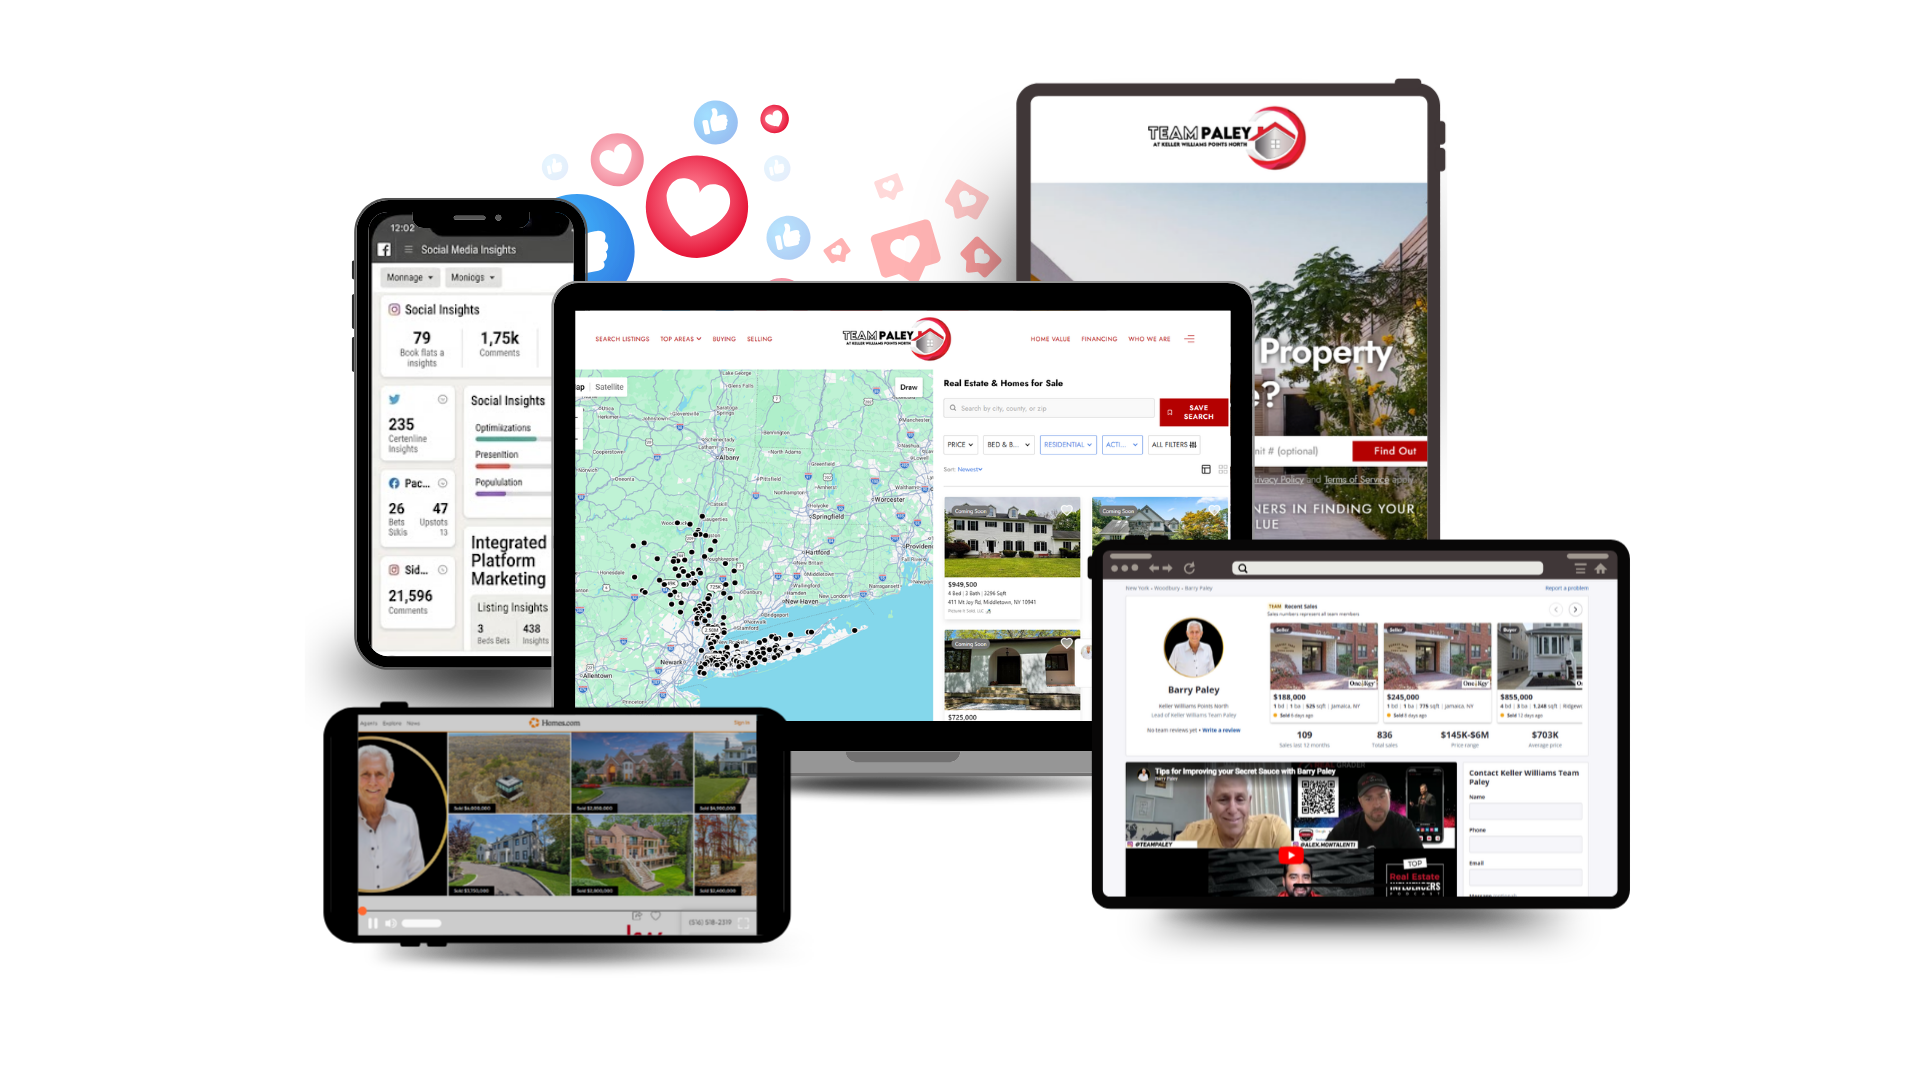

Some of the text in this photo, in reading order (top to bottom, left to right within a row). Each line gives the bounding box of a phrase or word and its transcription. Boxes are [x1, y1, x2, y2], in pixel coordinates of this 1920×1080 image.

[1148, 126, 1252, 140] TEAM PALEY
[391, 223, 416, 232] 12:02
[422, 245, 516, 256] Social Media Insights
[405, 304, 479, 317] Social Insights
[413, 331, 430, 344] 79
[481, 331, 519, 346] 1,75k
[842, 330, 914, 340] TEAM PALEY
[400, 348, 419, 357] Book
[480, 348, 520, 357] Comments
[1260, 337, 1393, 372] Property
[407, 359, 437, 369] insights
[1046, 379, 1063, 387] Sale
[472, 395, 545, 408] Social Insights
[389, 418, 414, 430] 235
[389, 444, 418, 455] Insights
[1268, 446, 1318, 457] # (optional)
[1375, 446, 1416, 455] Find Out
[1281, 475, 1304, 484] Policy
[1324, 475, 1347, 484] Terms
[1348, 475, 1358, 484] of
[1360, 475, 1390, 484] Service
[389, 503, 404, 514] 26
[433, 503, 448, 514] 47
[1292, 504, 1415, 514] IN FINDING YOUR
[472, 535, 546, 553] Integrated
[472, 551, 535, 567] Platform
[472, 571, 546, 589] Marketing
[389, 590, 432, 604] 21,596
[388, 606, 428, 614] Comments
[478, 602, 548, 614] Listing Insights
[478, 624, 483, 633] 3
[523, 624, 540, 633] 438
[523, 637, 549, 646] Insights
[1169, 686, 1220, 696] Barry Paley
[947, 713, 978, 722] $725,000
[1297, 731, 1312, 739] 109
[1377, 731, 1392, 739] 836
[1441, 731, 1489, 739] $145K-$6M
[1532, 731, 1558, 739] $703K
[1154, 768, 1170, 776] Tips
[1183, 768, 1217, 777] Improving
[1297, 768, 1315, 776] Barry
[1317, 768, 1336, 776] Paley
[1469, 779, 1489, 787] Paley
